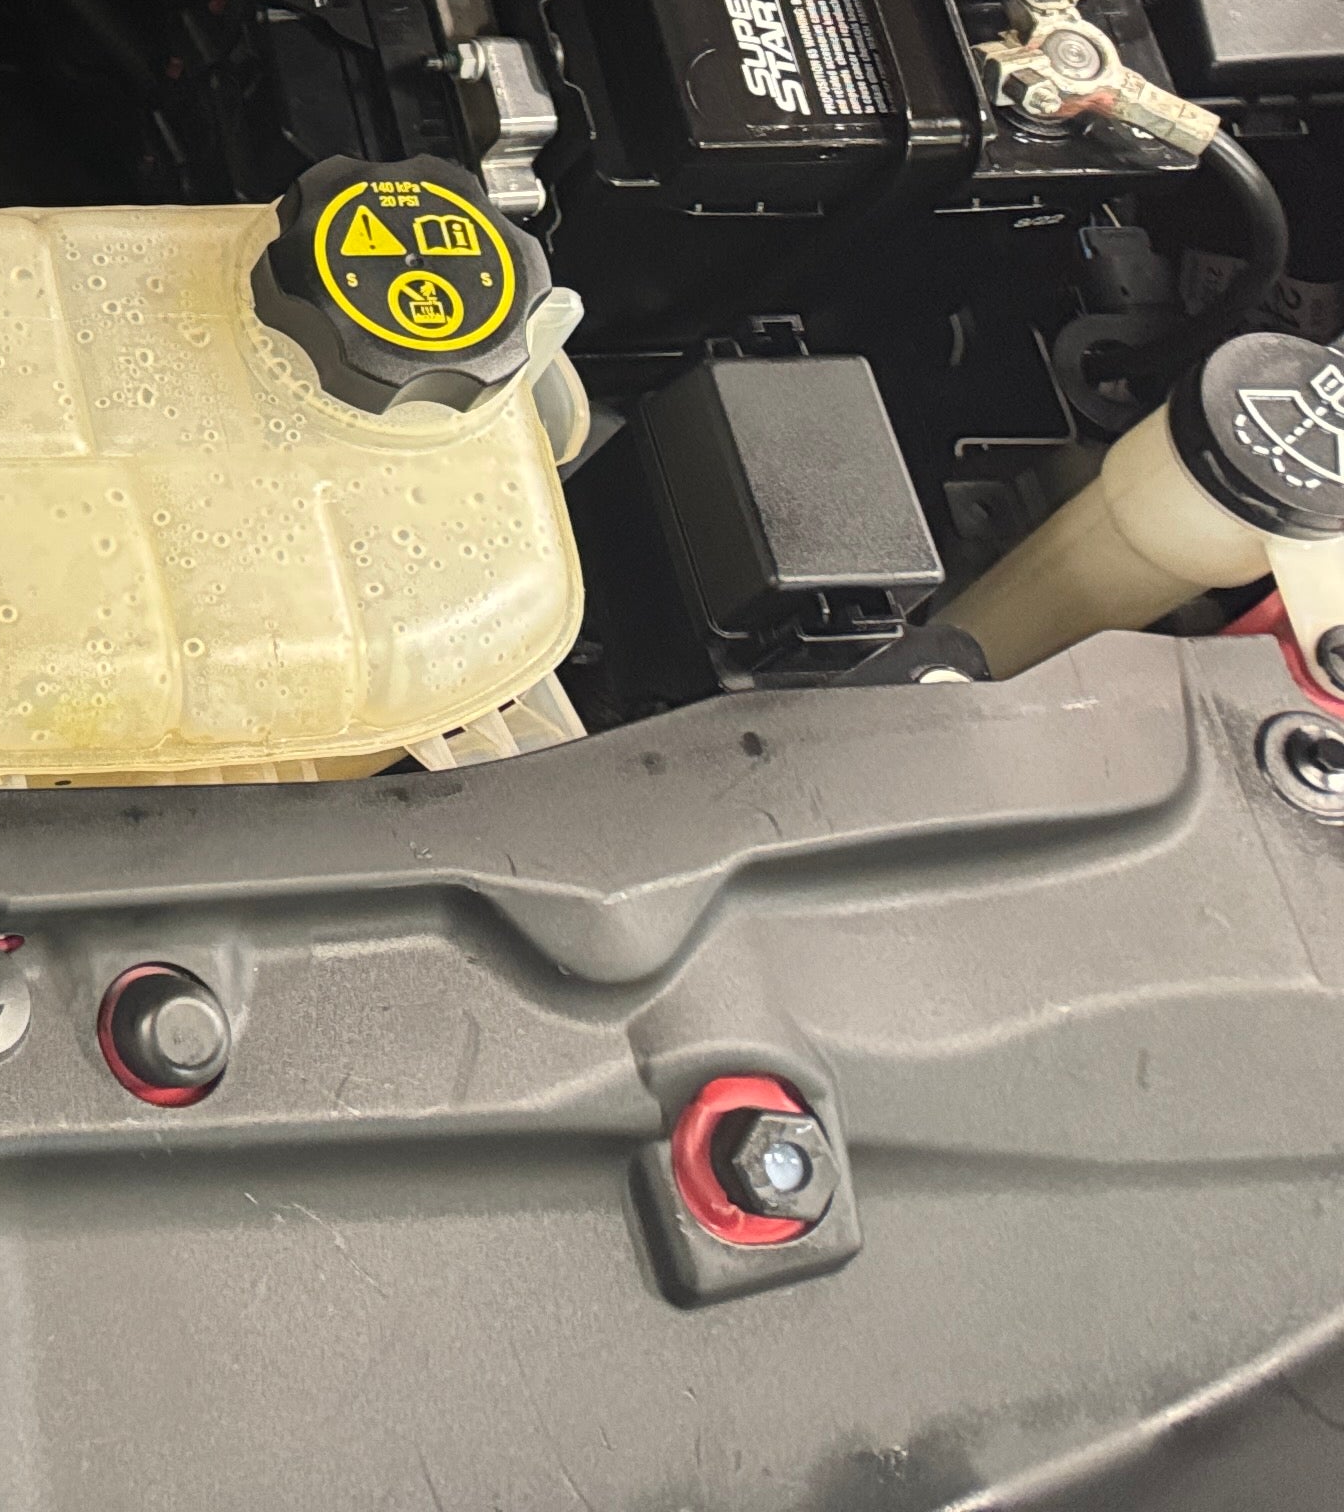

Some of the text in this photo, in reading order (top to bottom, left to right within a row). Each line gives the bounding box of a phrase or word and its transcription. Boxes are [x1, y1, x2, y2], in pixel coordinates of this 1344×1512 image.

[810, 60, 836, 114] PROPOSITION
[370, 182, 420, 194] 140 kPa
[380, 196, 420, 208] 20 PSI
[346, 273, 358, 287] S
[480, 272, 493, 287] S
